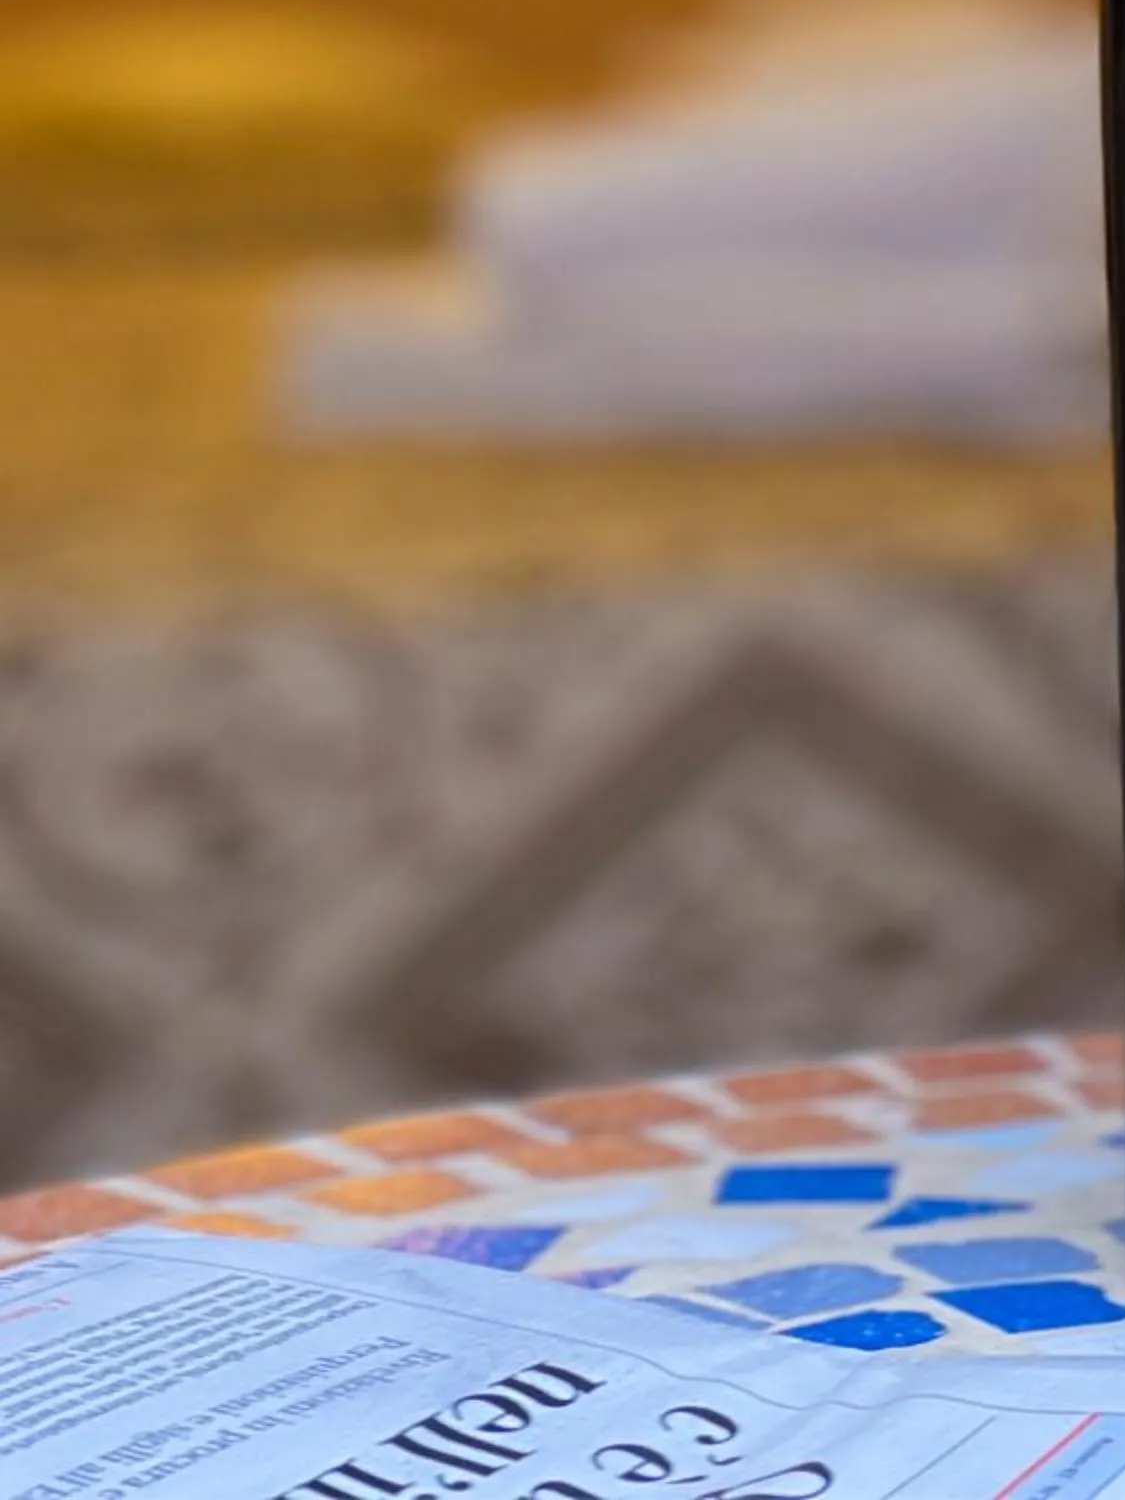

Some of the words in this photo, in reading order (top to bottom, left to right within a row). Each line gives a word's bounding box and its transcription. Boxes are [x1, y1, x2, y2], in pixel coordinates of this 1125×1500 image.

[207, 1336, 411, 1417] Perquisizioni
[97, 1422, 195, 1466] sigilli
[186, 1414, 215, 1426] e
[119, 1428, 250, 1488] procura
